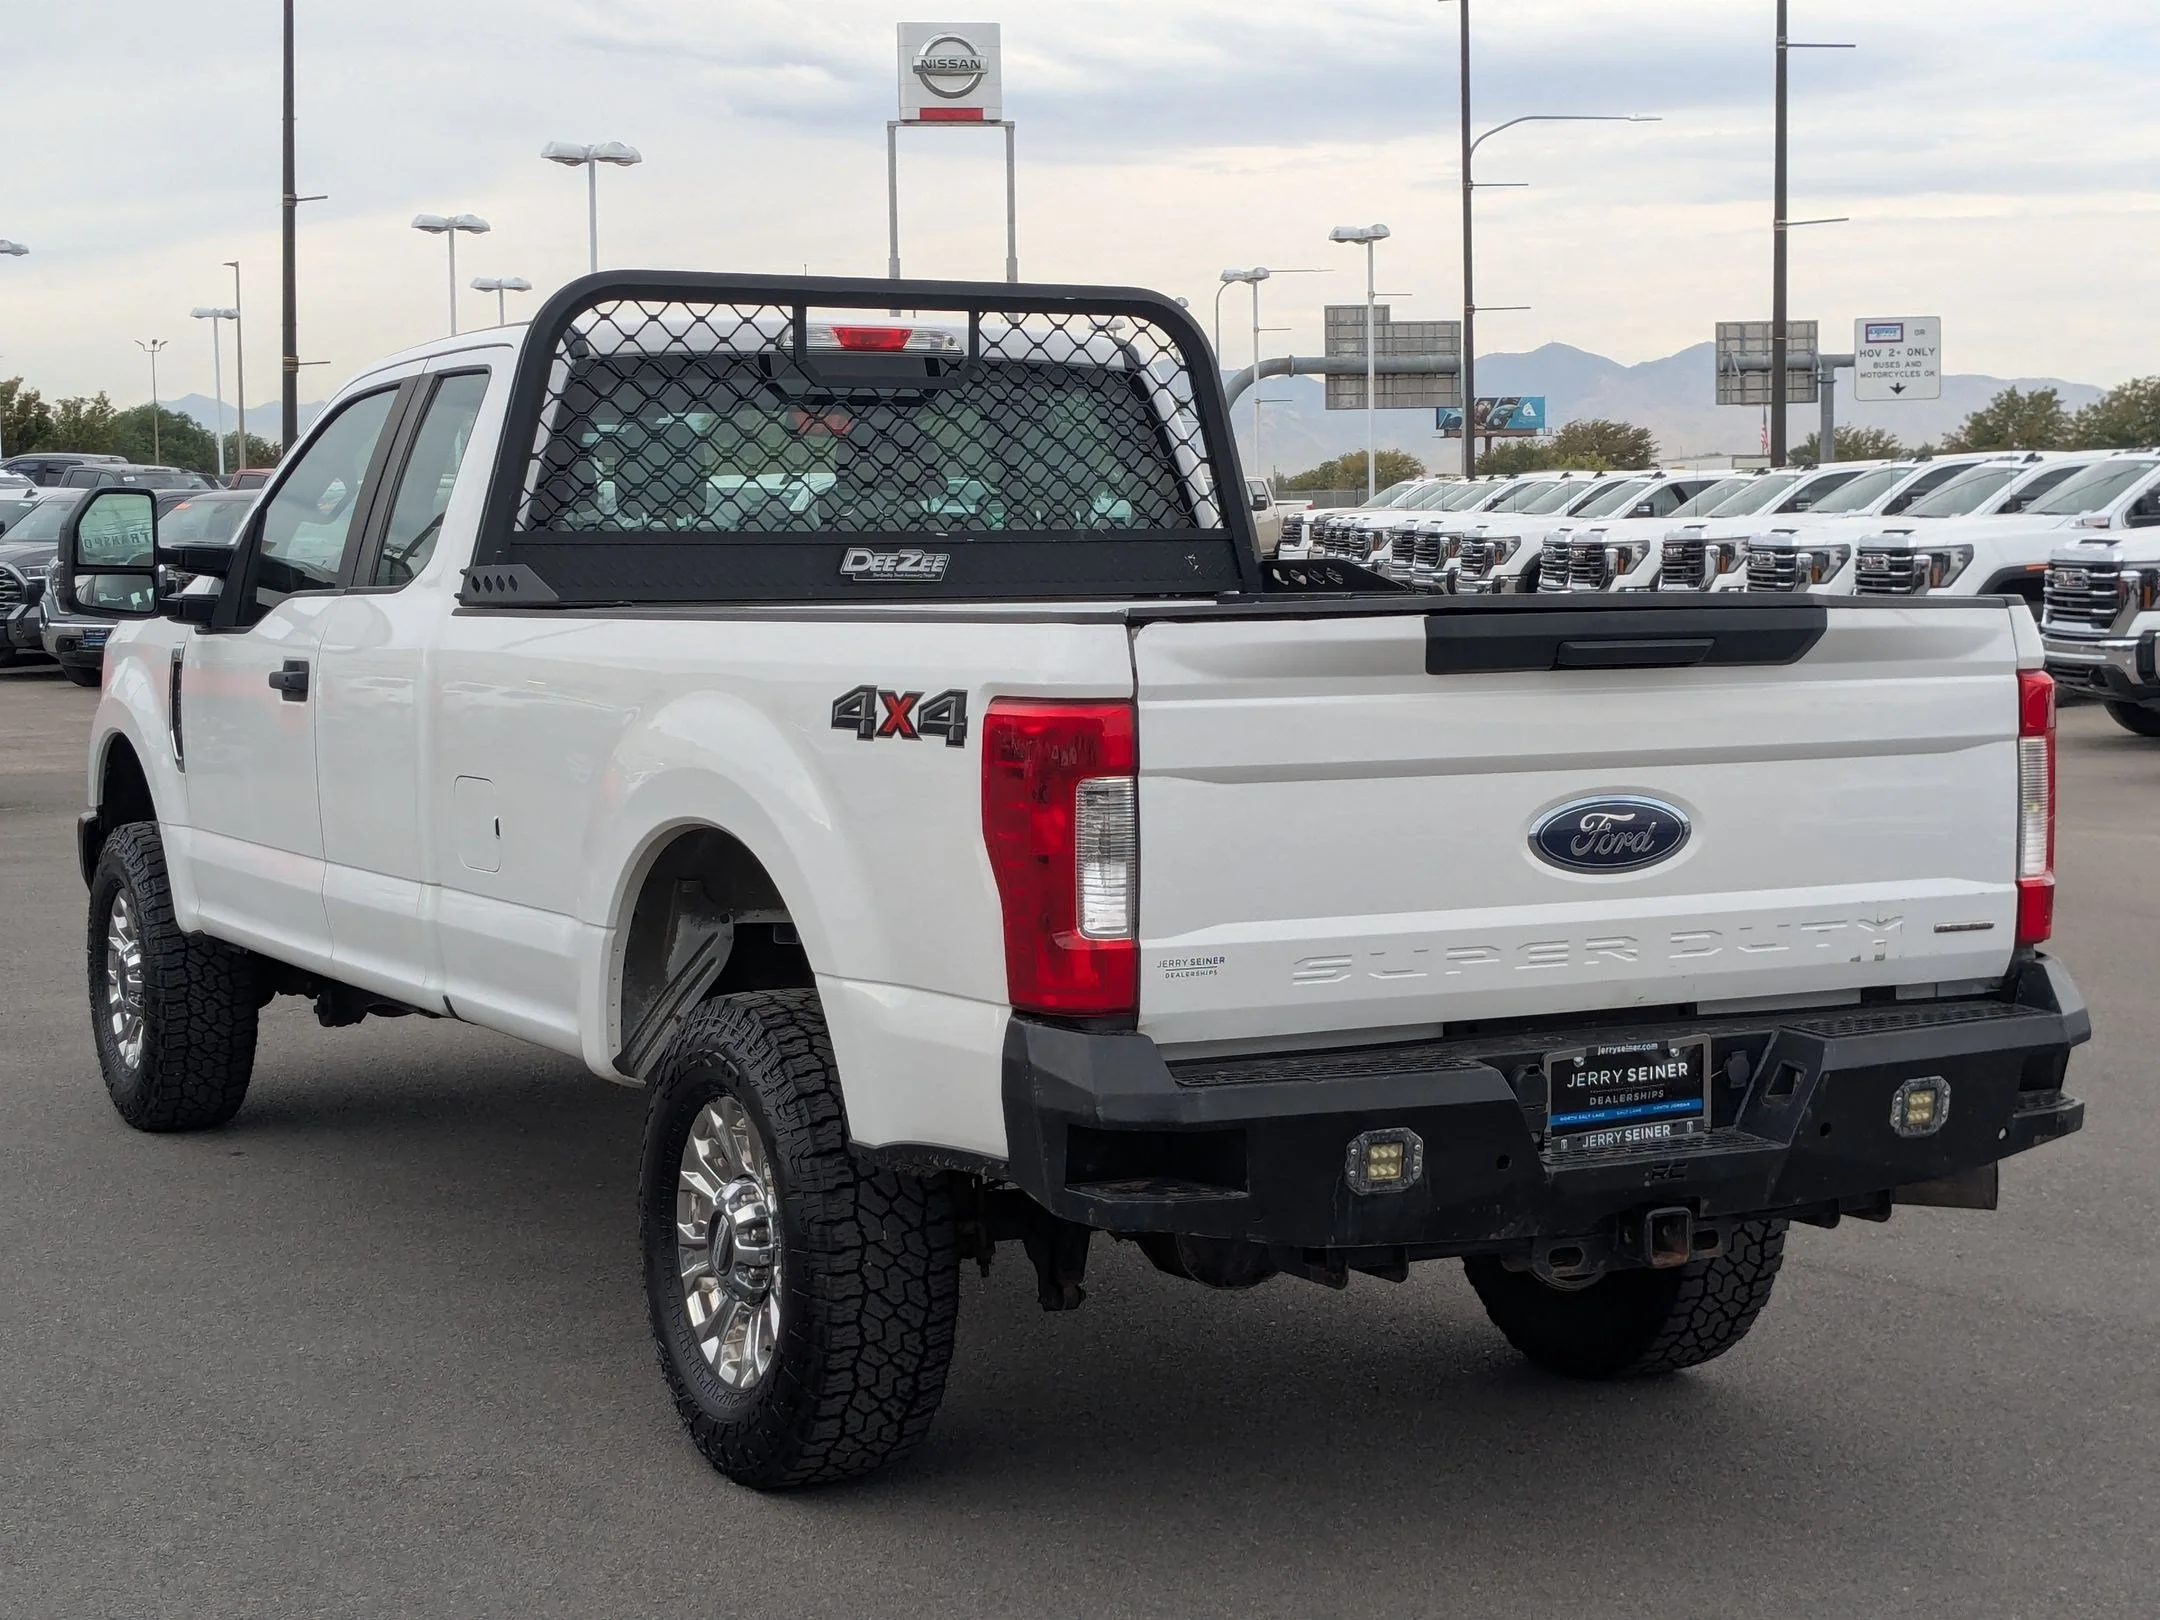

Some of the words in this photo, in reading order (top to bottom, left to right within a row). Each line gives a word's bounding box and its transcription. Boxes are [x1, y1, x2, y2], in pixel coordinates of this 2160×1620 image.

[921, 58, 981, 69] NISSAN
[1859, 348, 1882, 358] HOV
[1888, 348, 1901, 357] 2+
[1907, 347, 1936, 357] ONLY
[1873, 361, 1900, 369] BUSES
[1905, 360, 1922, 368] AND
[1860, 370, 1921, 378] MOTORCYCLES
[1571, 813, 1657, 856] Ford
[1292, 936, 1638, 985] SUPER
[1668, 915, 1904, 962] DUTY
[1157, 959, 1188, 968] JERRY
[1190, 956, 1225, 966] SEINER
[1165, 969, 1218, 979] DEALERSHIPS
[1597, 1042, 1659, 1056] jerryseiner.com
[1567, 1069, 1623, 1088] JERRY
[1627, 1062, 1689, 1082] SEINER
[1590, 1090, 1665, 1106] DEALERSHIPS
[1582, 1131, 1622, 1148] JERRY
[1625, 1124, 1671, 1141] SEINER
